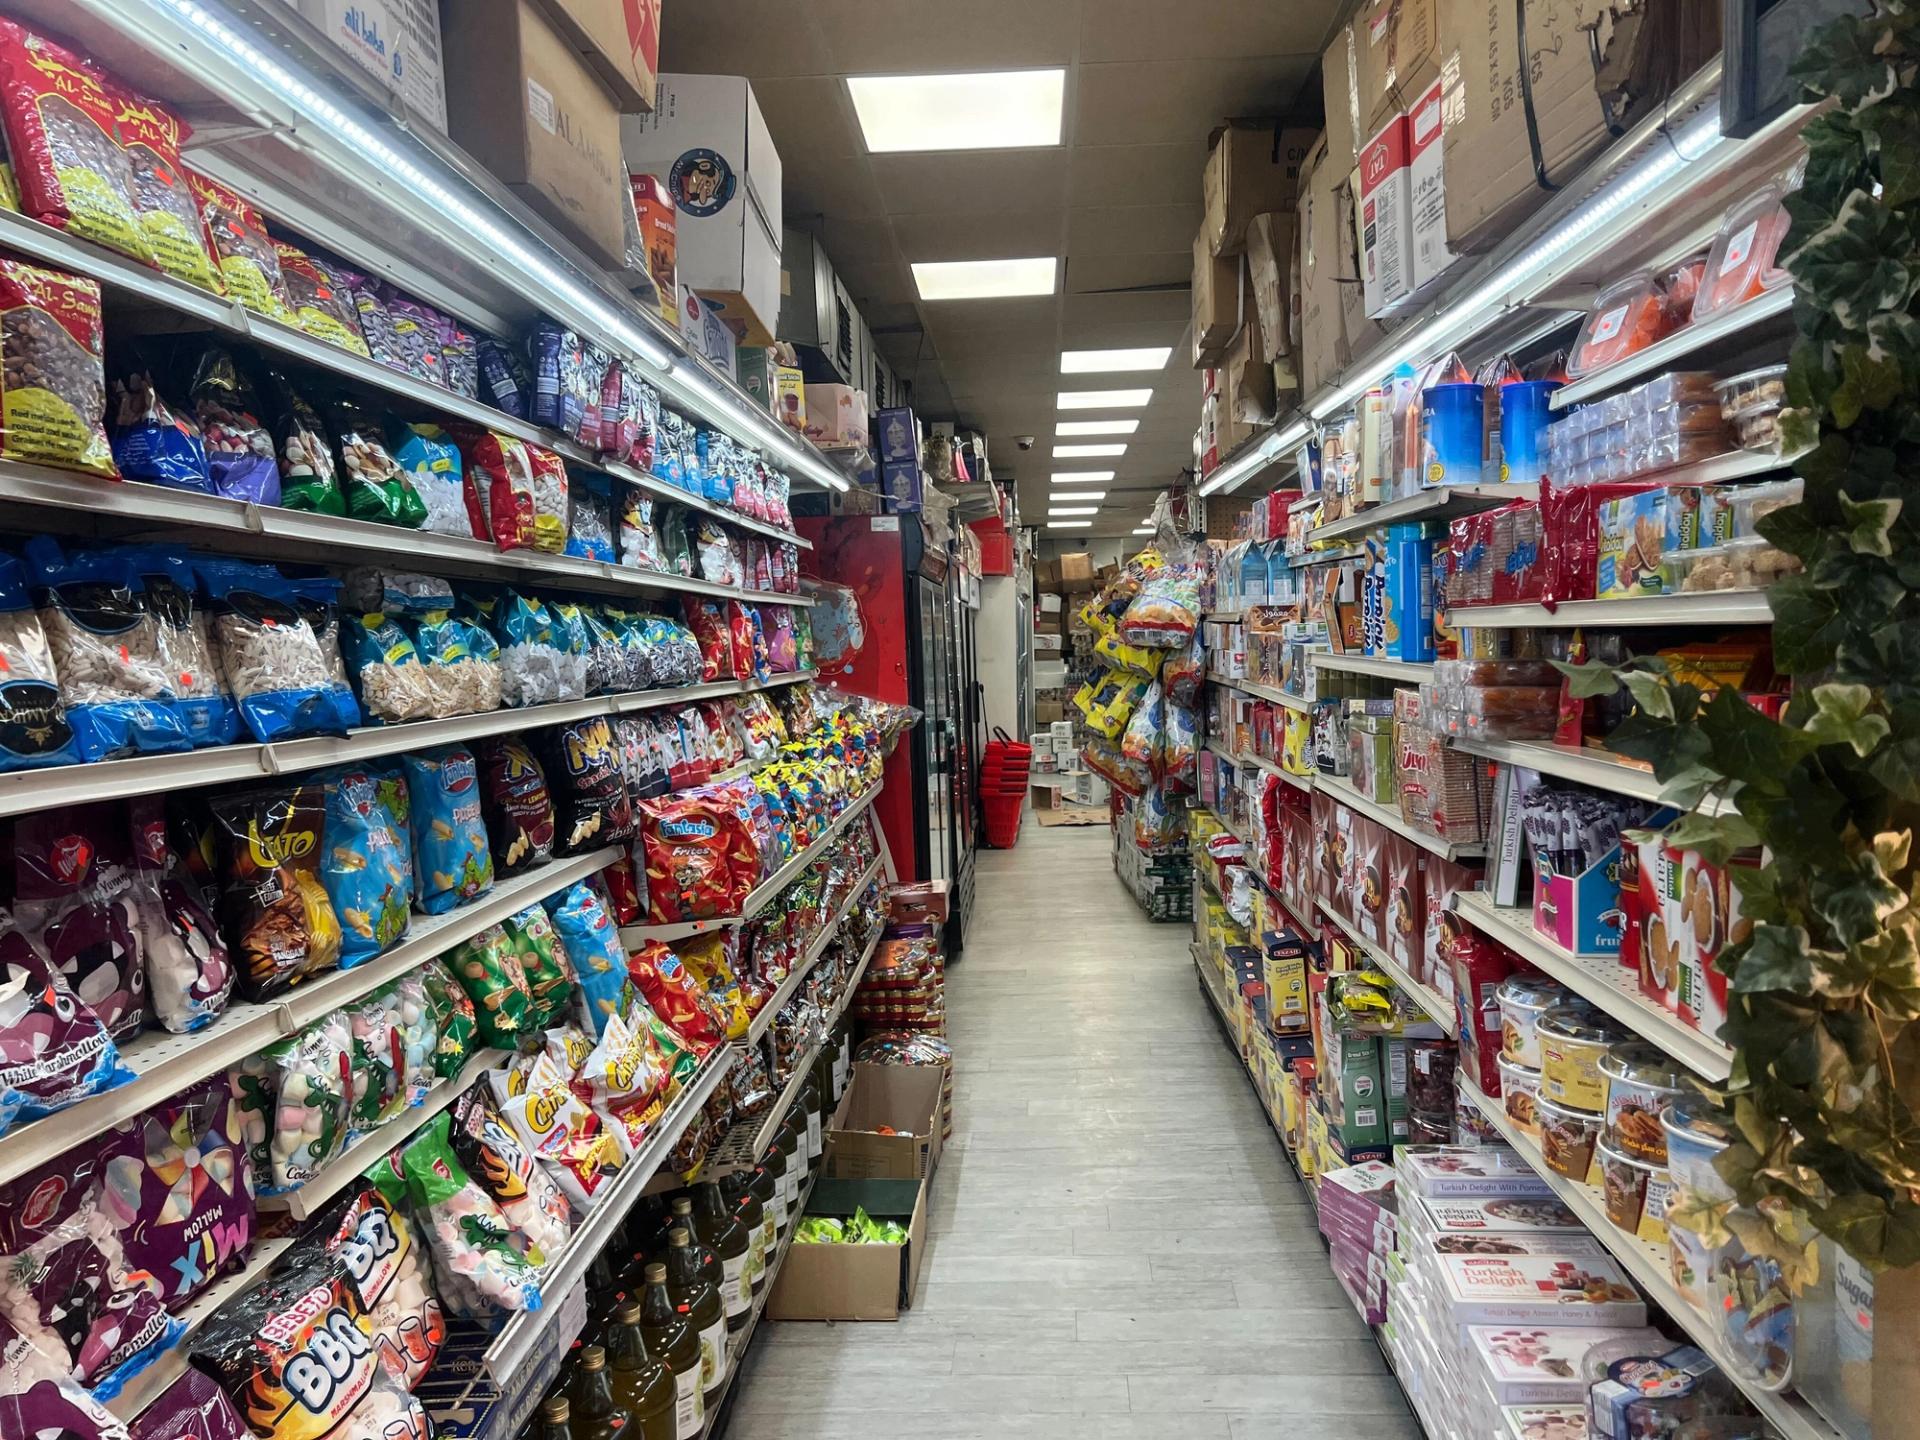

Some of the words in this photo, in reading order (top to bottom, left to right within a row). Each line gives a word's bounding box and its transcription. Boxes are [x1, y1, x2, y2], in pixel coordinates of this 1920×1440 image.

[1531, 51, 1543, 84] PCS
[1369, 157, 1386, 180] TAT
[1507, 789, 1520, 824] Delight
[659, 817, 715, 839] Fantasia
[1504, 827, 1515, 865] Turkish
[2, 1069, 37, 1086] White
[1353, 1152, 1385, 1160] TAZAH
[1441, 1182, 1467, 1191] Turkish
[1470, 1182, 1496, 1193] Delight
[1500, 1182, 1517, 1191] With
[183, 1204, 223, 1242] MALLOW
[170, 1214, 249, 1296] MIX
[1462, 1268, 1523, 1278] Turkish
[1466, 1277, 1527, 1287] Delight
[262, 1287, 331, 1342] BEBETO
[282, 1307, 370, 1414] BBQ
[330, 1362, 370, 1418] MARSHMALLOW
